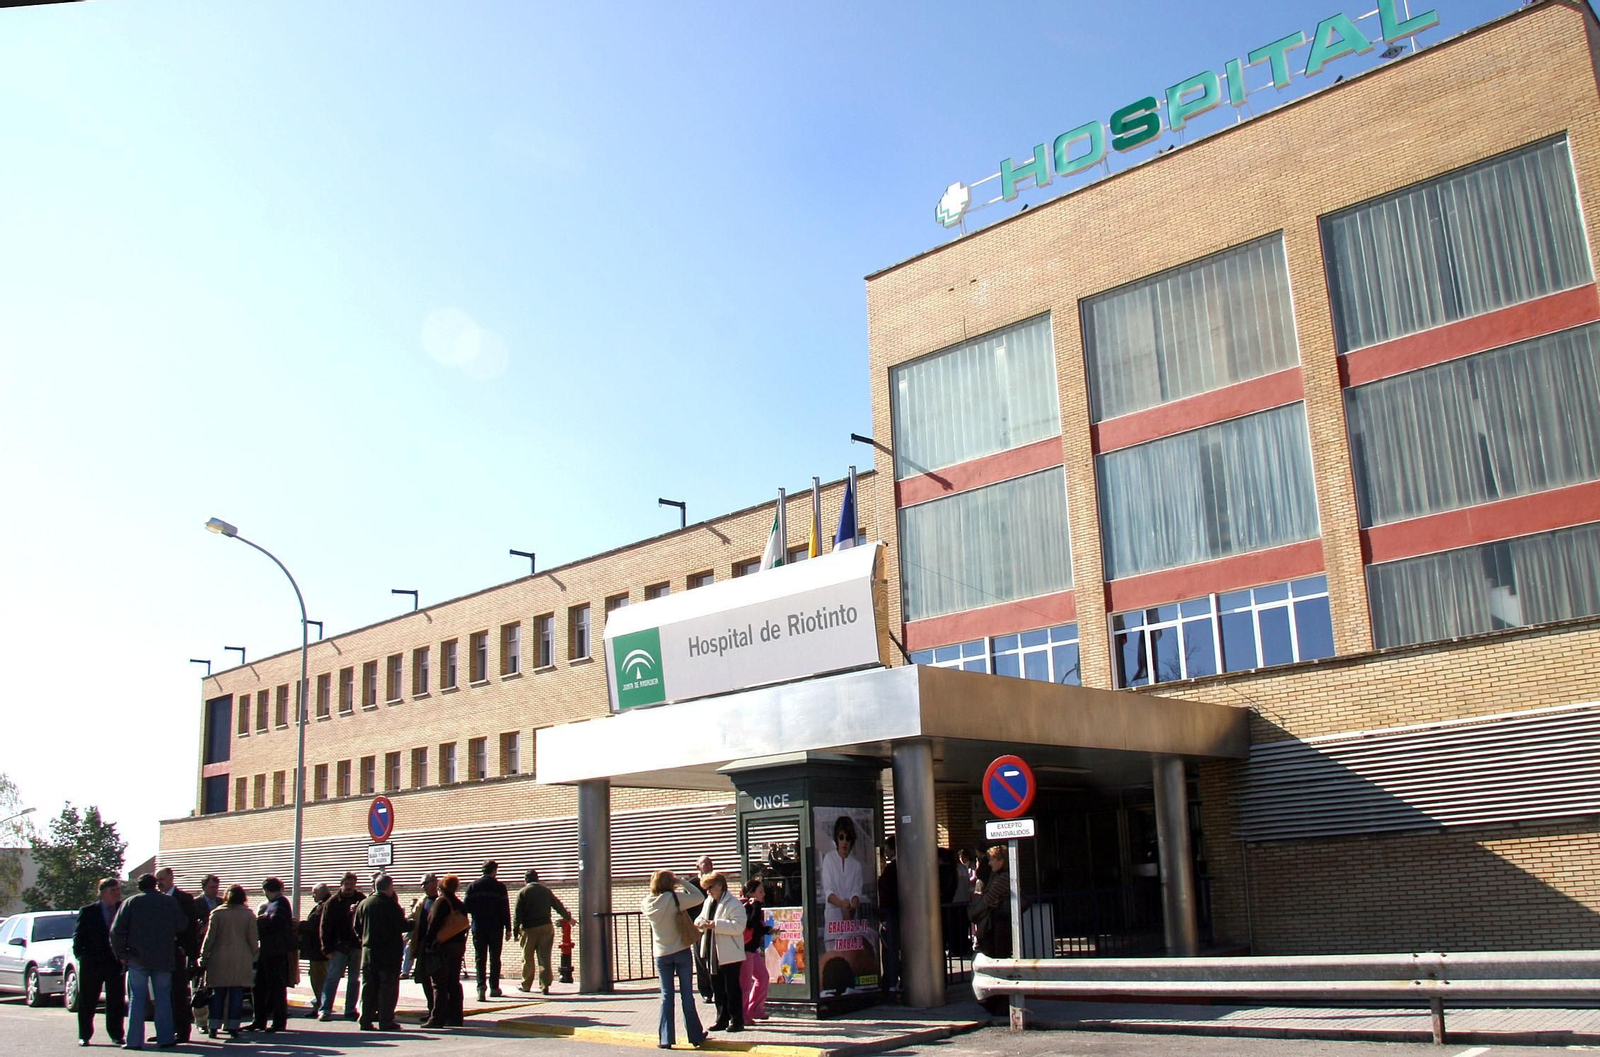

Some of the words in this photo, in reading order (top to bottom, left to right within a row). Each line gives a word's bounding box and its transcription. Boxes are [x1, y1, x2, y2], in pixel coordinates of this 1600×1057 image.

[1000, 0, 1439, 202] HOSPITAL
[688, 624, 753, 658] Hospital
[760, 620, 781, 642] de
[787, 604, 858, 637] Riotinto
[622, 683, 634, 691] JUNTA
[634, 681, 640, 689] DE
[753, 793, 790, 810] ONCE
[997, 821, 1022, 829] EXCEPTO
[990, 829, 1030, 837] MINUSVALIDOS
[828, 920, 854, 933] GRACIAS
[860, 976, 877, 984] ONCE
